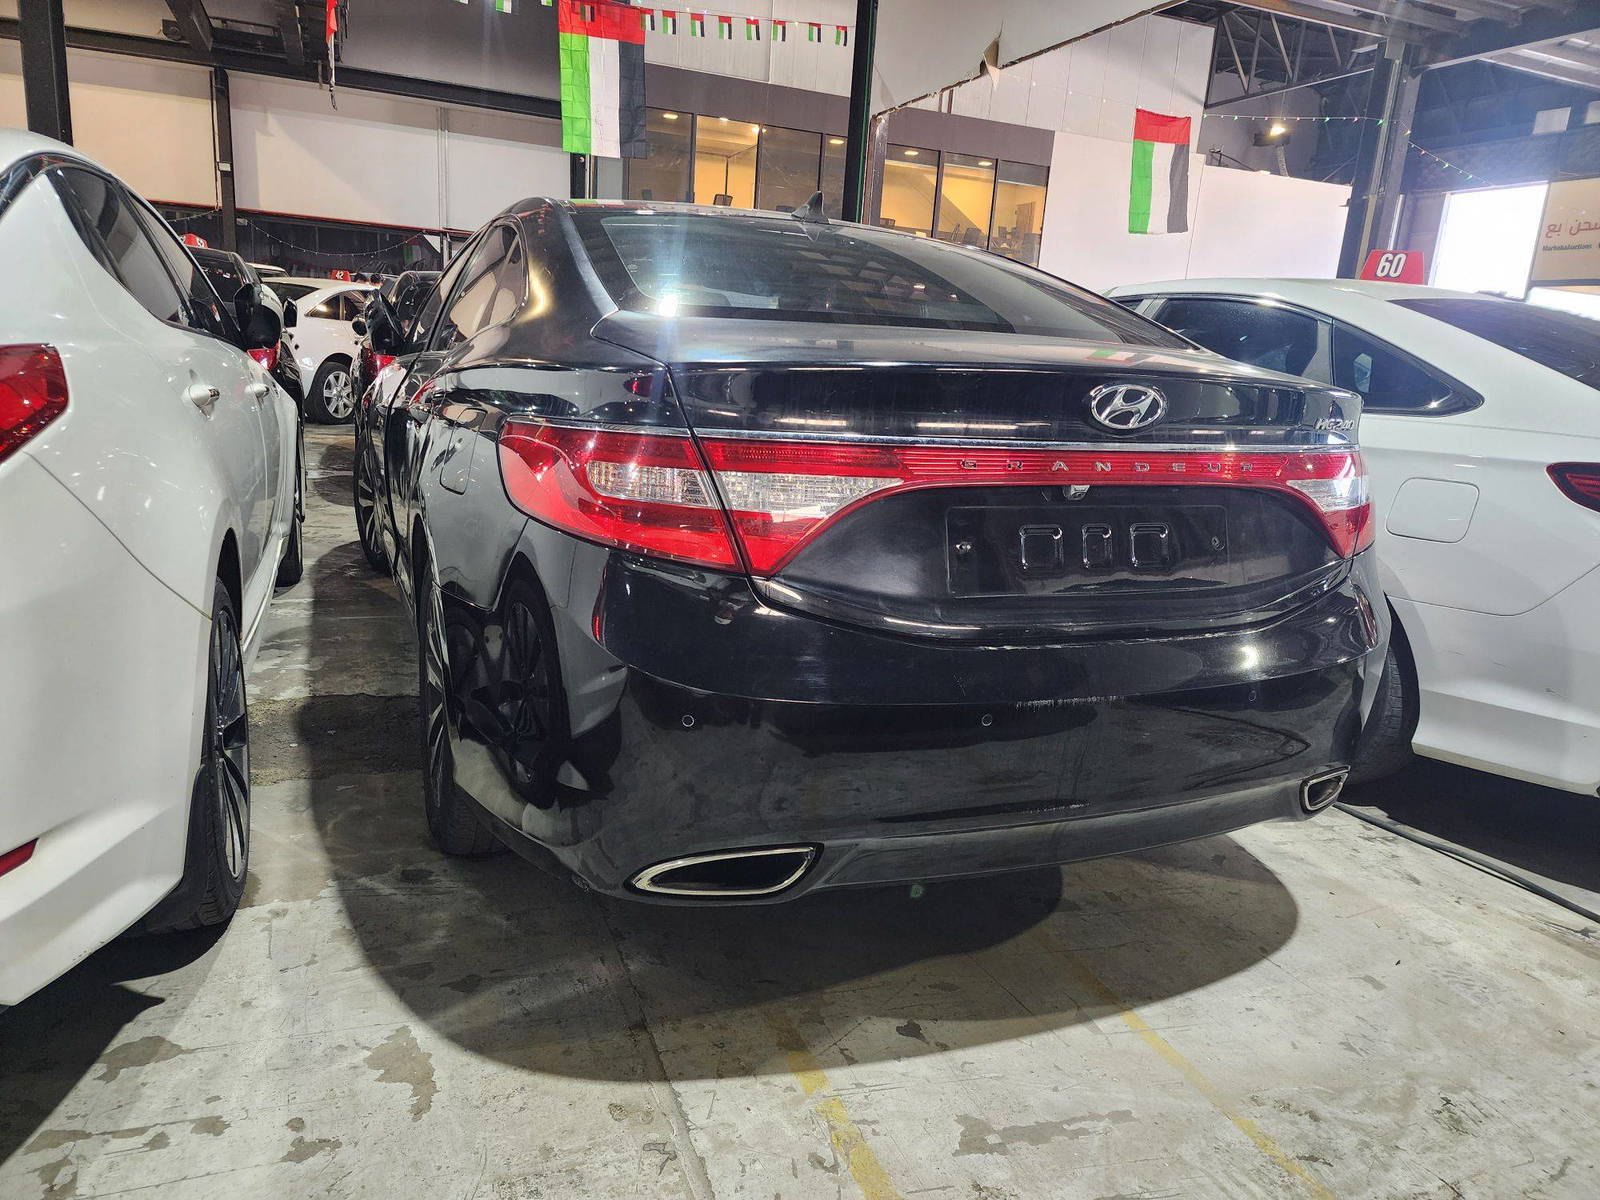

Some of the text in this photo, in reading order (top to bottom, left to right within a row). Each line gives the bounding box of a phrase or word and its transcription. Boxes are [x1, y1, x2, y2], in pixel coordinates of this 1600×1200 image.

[1545, 223, 1563, 239] بع
[1375, 253, 1408, 278] 60
[960, 459, 1254, 472] GRANDEUR
